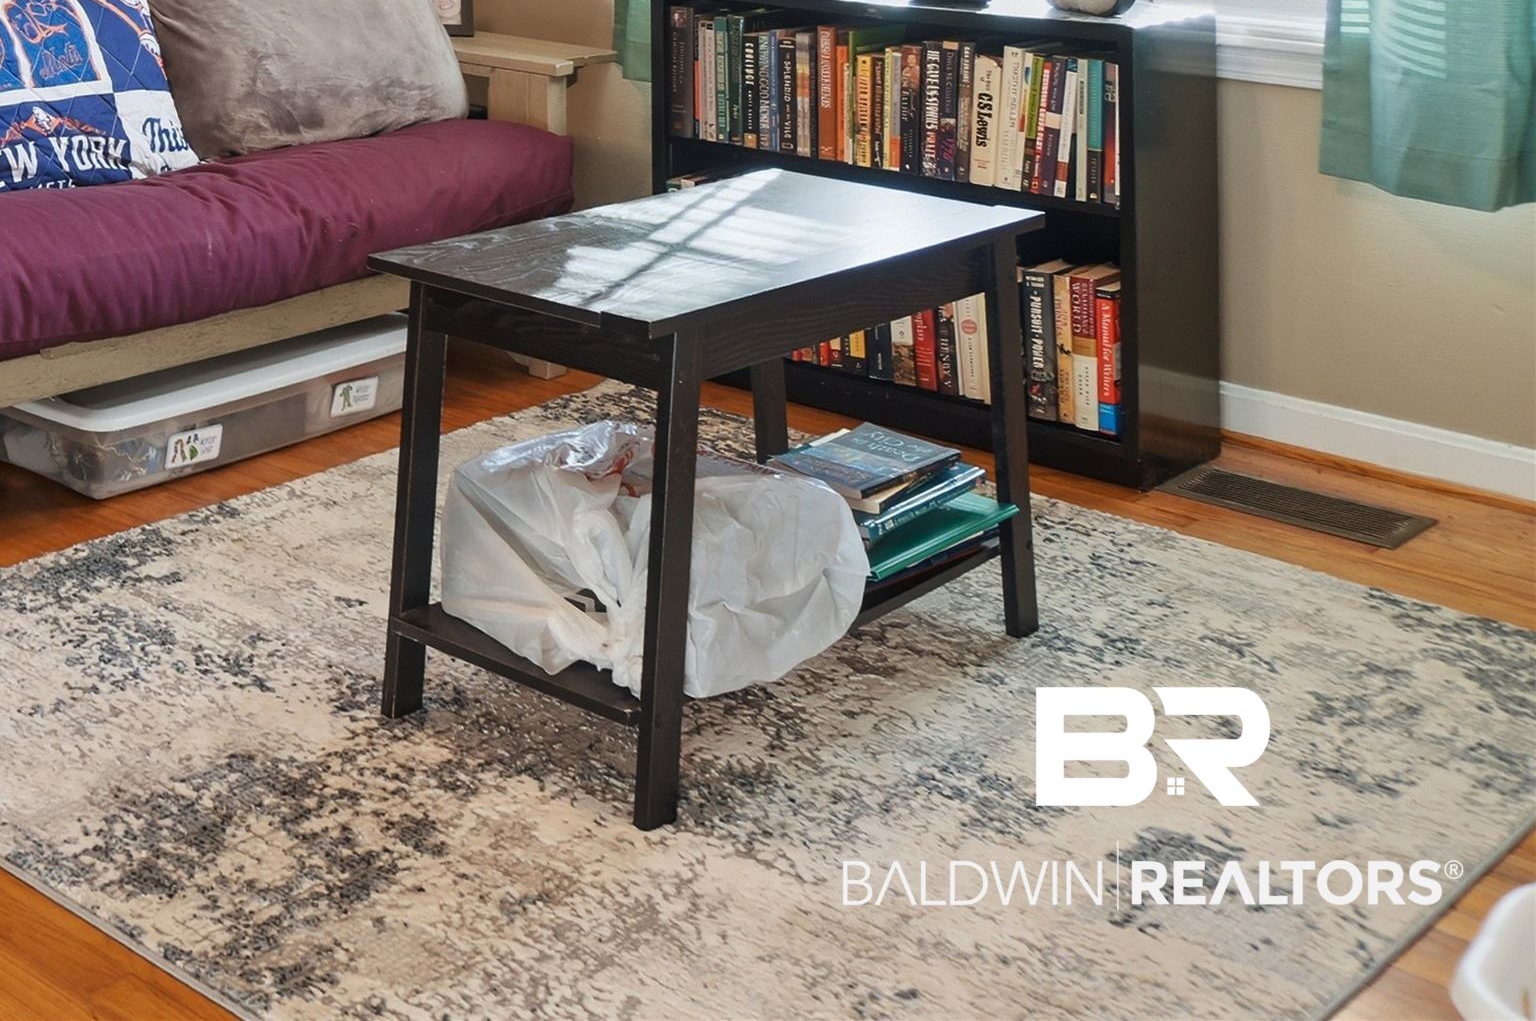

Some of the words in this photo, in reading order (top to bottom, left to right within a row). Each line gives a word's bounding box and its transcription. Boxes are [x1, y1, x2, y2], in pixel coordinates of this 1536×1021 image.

[48, 135, 128, 172] YORK
[1030, 296, 1043, 333] PURSUIT
[1031, 338, 1044, 368] POWER
